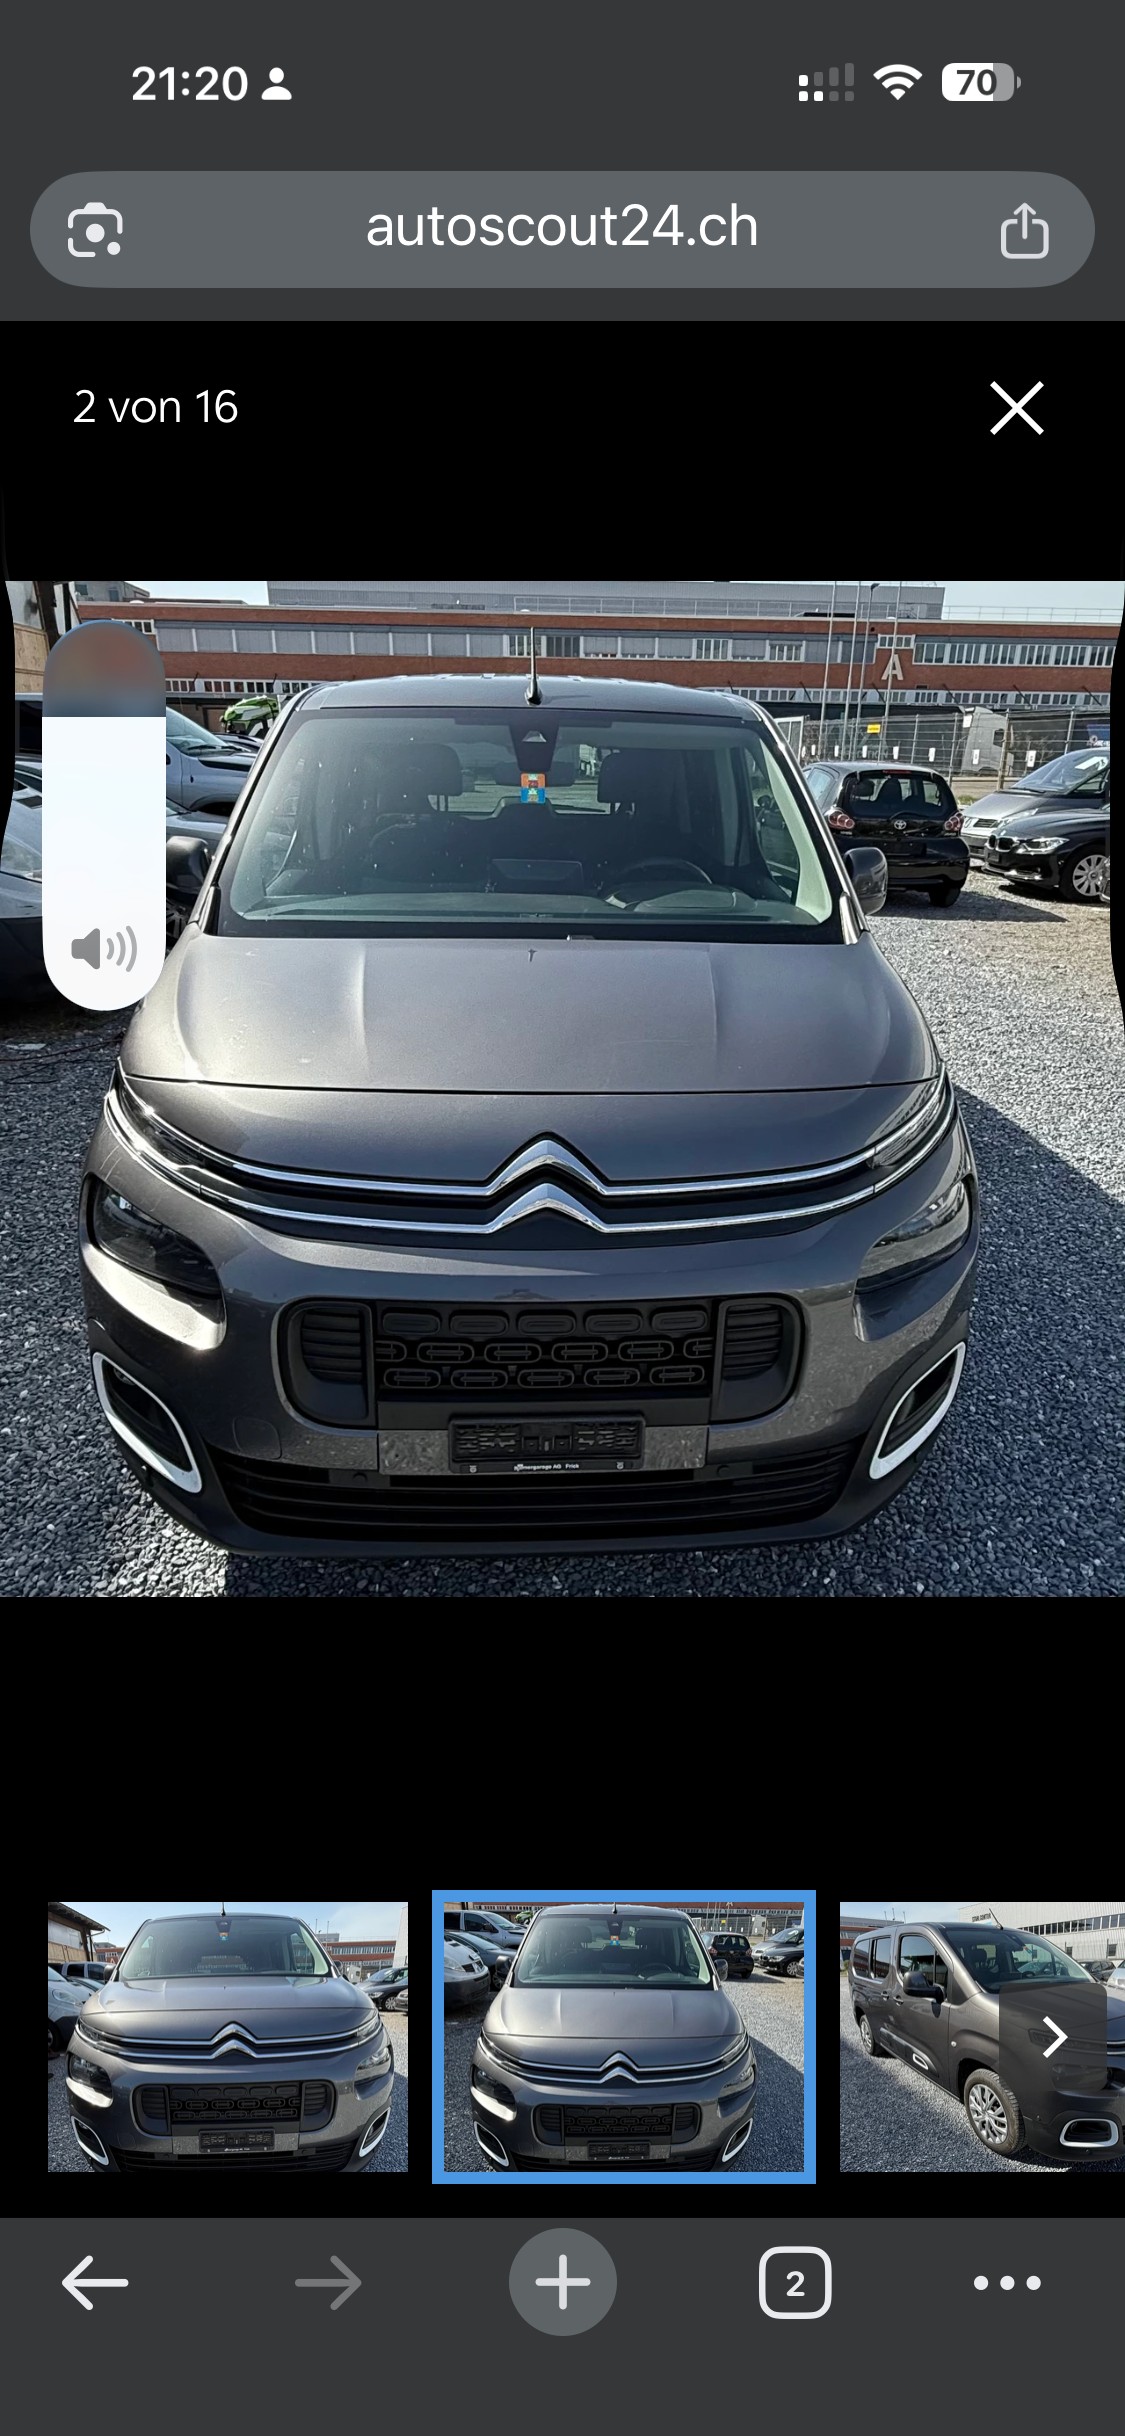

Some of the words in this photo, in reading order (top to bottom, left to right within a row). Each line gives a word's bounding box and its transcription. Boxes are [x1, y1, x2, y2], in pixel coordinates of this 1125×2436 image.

[132, 66, 248, 101] 21:20
[956, 69, 998, 97] 70
[367, 203, 757, 247] autoscout24.ch
[74, 390, 96, 422] 2
[109, 398, 181, 423] von
[197, 390, 238, 423] 16
[881, 654, 904, 681] A
[786, 2271, 806, 2297] 2
